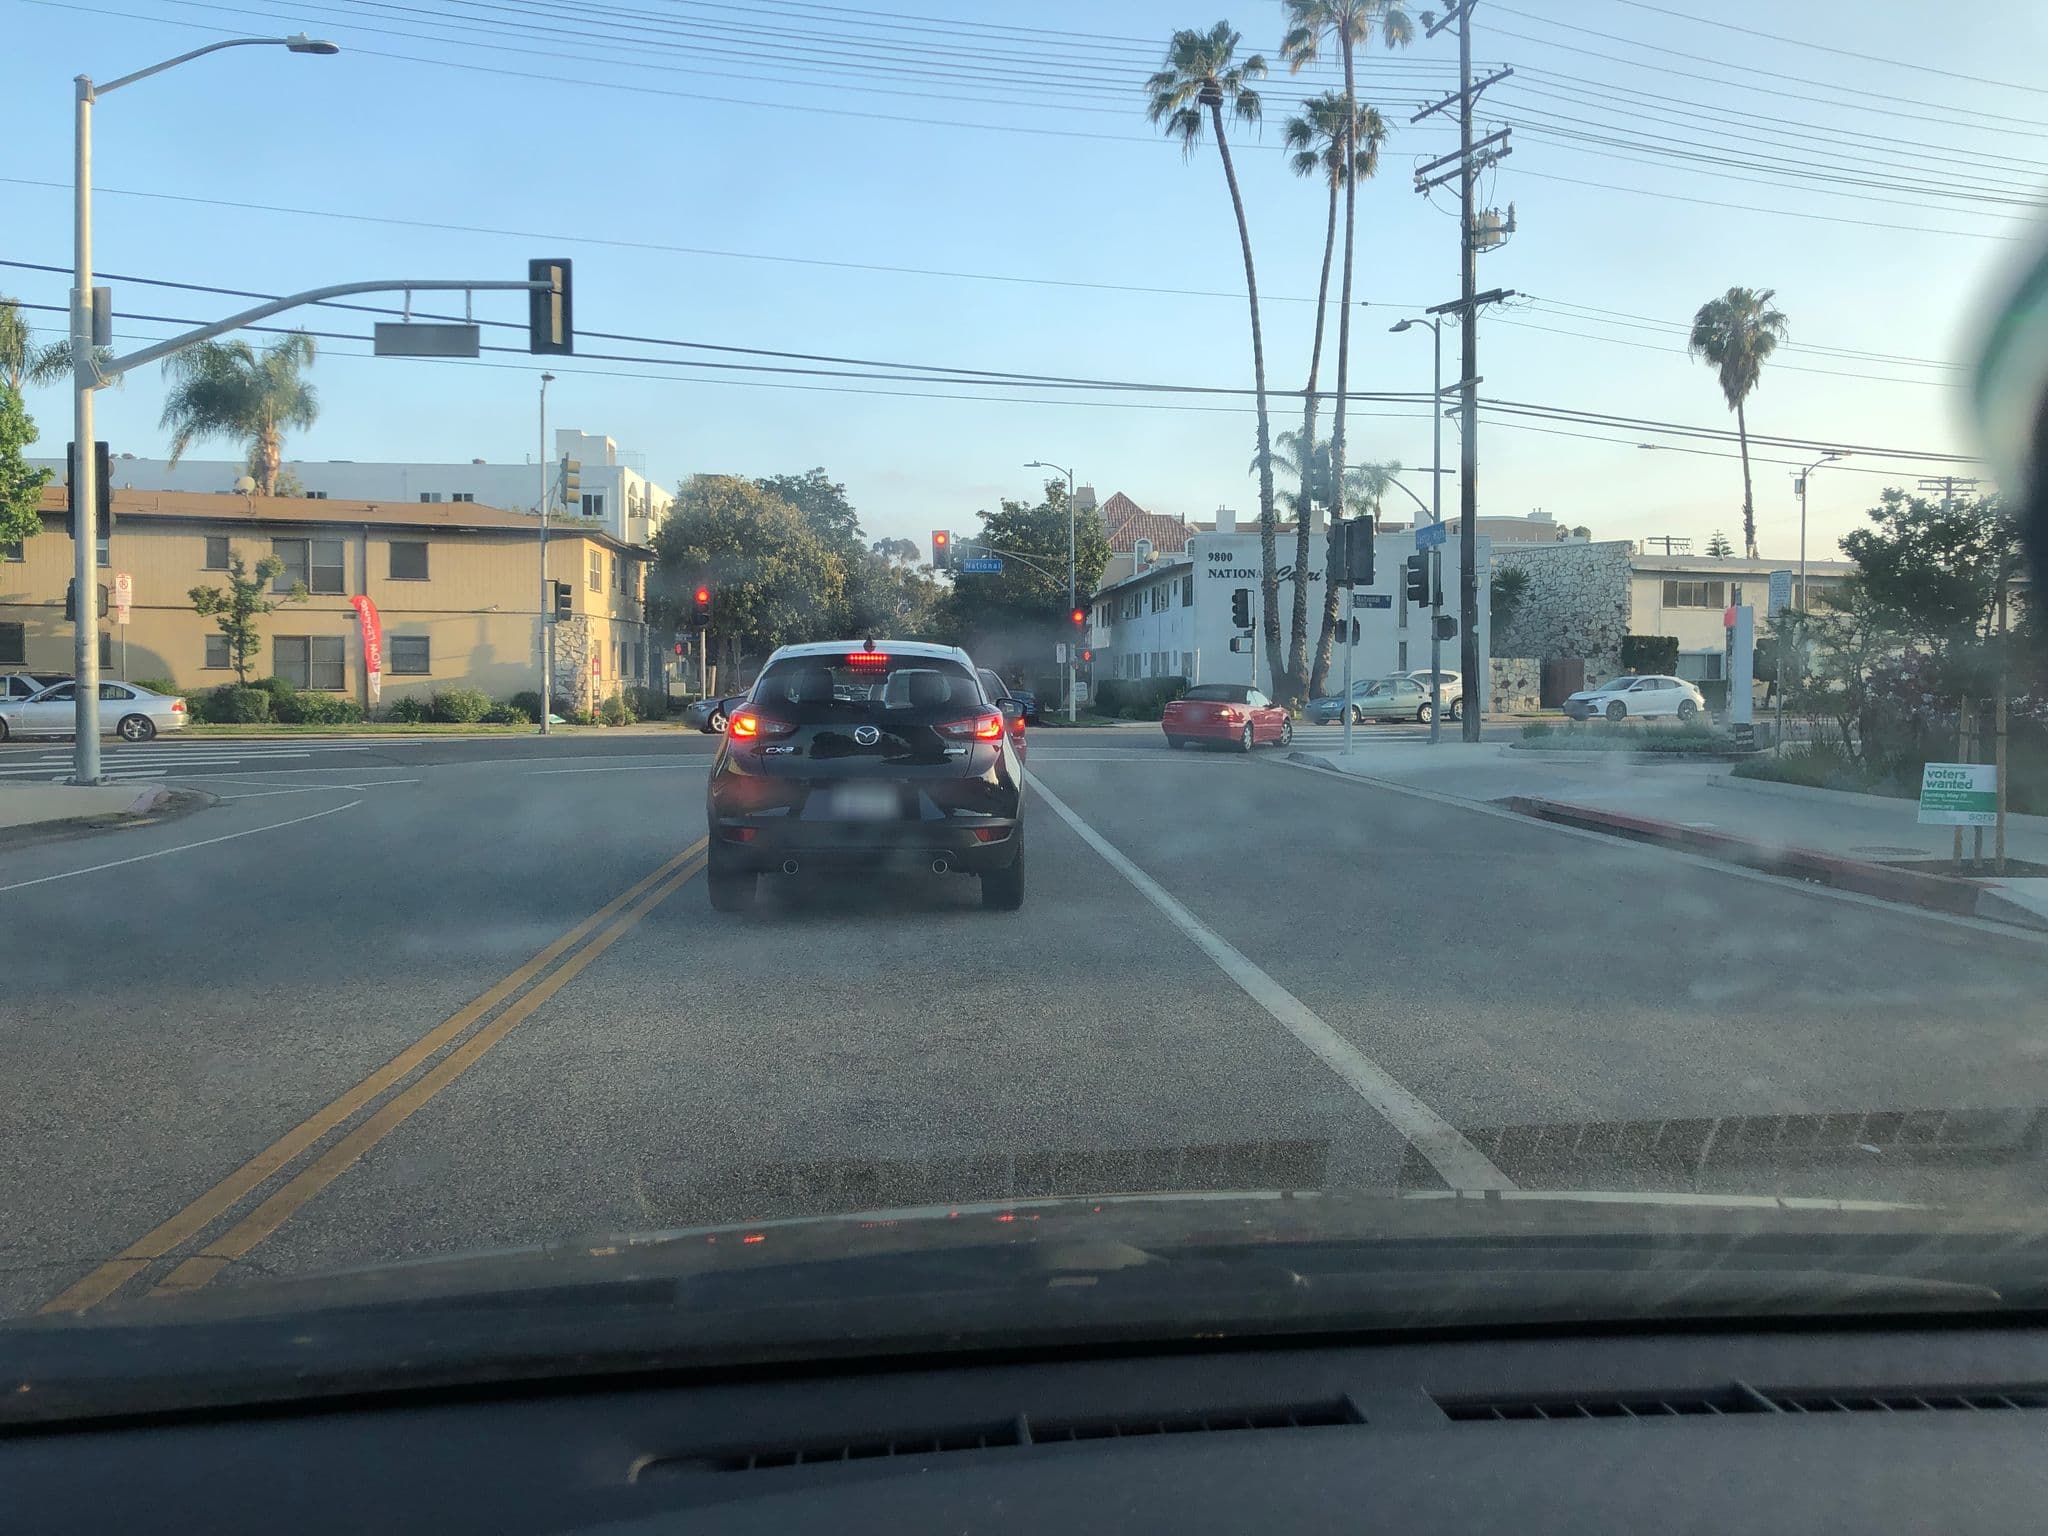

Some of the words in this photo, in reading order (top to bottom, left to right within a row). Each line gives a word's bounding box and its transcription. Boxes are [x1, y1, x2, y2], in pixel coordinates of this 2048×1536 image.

[1208, 552, 1233, 562] 9800
[370, 643, 382, 669] NOW
[765, 746, 795, 754] CX-3
[1927, 770, 1966, 779] voters
[1926, 779, 1973, 789] wanted
